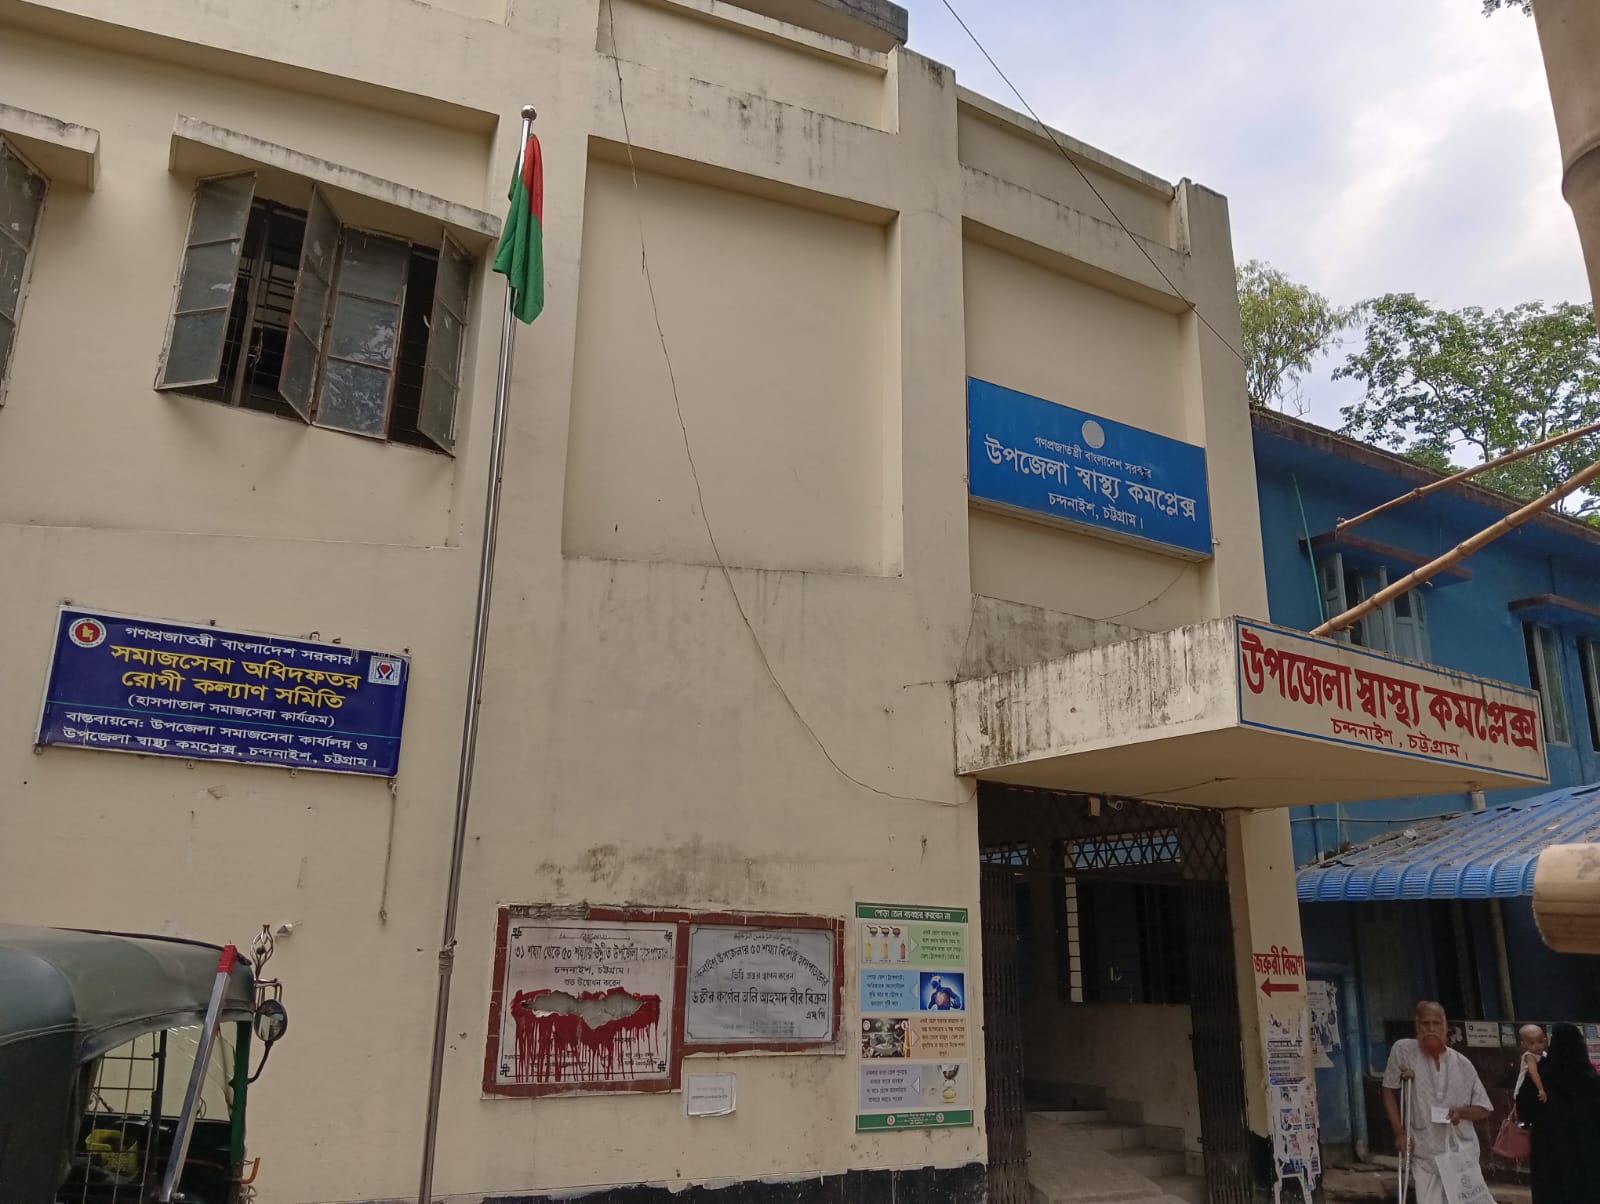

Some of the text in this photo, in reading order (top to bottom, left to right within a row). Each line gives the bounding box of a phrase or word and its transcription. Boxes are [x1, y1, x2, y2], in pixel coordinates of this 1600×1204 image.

[984, 433, 1197, 522] উপজেলা স্বাস্থ্য কমপ্লেক্স
[1084, 450, 1122, 471] বাংলাদেশ
[109, 644, 362, 690] সমাজসেবা অধিদফতর
[221, 639, 297, 658] বাংলাদেশ
[300, 649, 354, 666] সরকার
[122, 669, 347, 709] রোগী কল্যাণ সমিতি
[1241, 628, 1539, 753] উপজেলা স্বাস্থ্য কমপ্লেক্স
[128, 694, 335, 728] (হাসপাতাল সমাজসেবা কার্যক্রম)
[62, 727, 131, 745] উপজেলা
[135, 735, 170, 750] স্বাস্থ্য
[149, 717, 216, 736] উপজেলা
[219, 727, 294, 744] সমাজসেবা
[298, 735, 353, 750] কার্যালয়
[356, 741, 368, 751] ও
[1253, 945, 1281, 976] জরুরী
[759, 992, 787, 1006] আহমদ
[789, 987, 803, 1006] বীর
[805, 987, 827, 1005] বিক্রম
